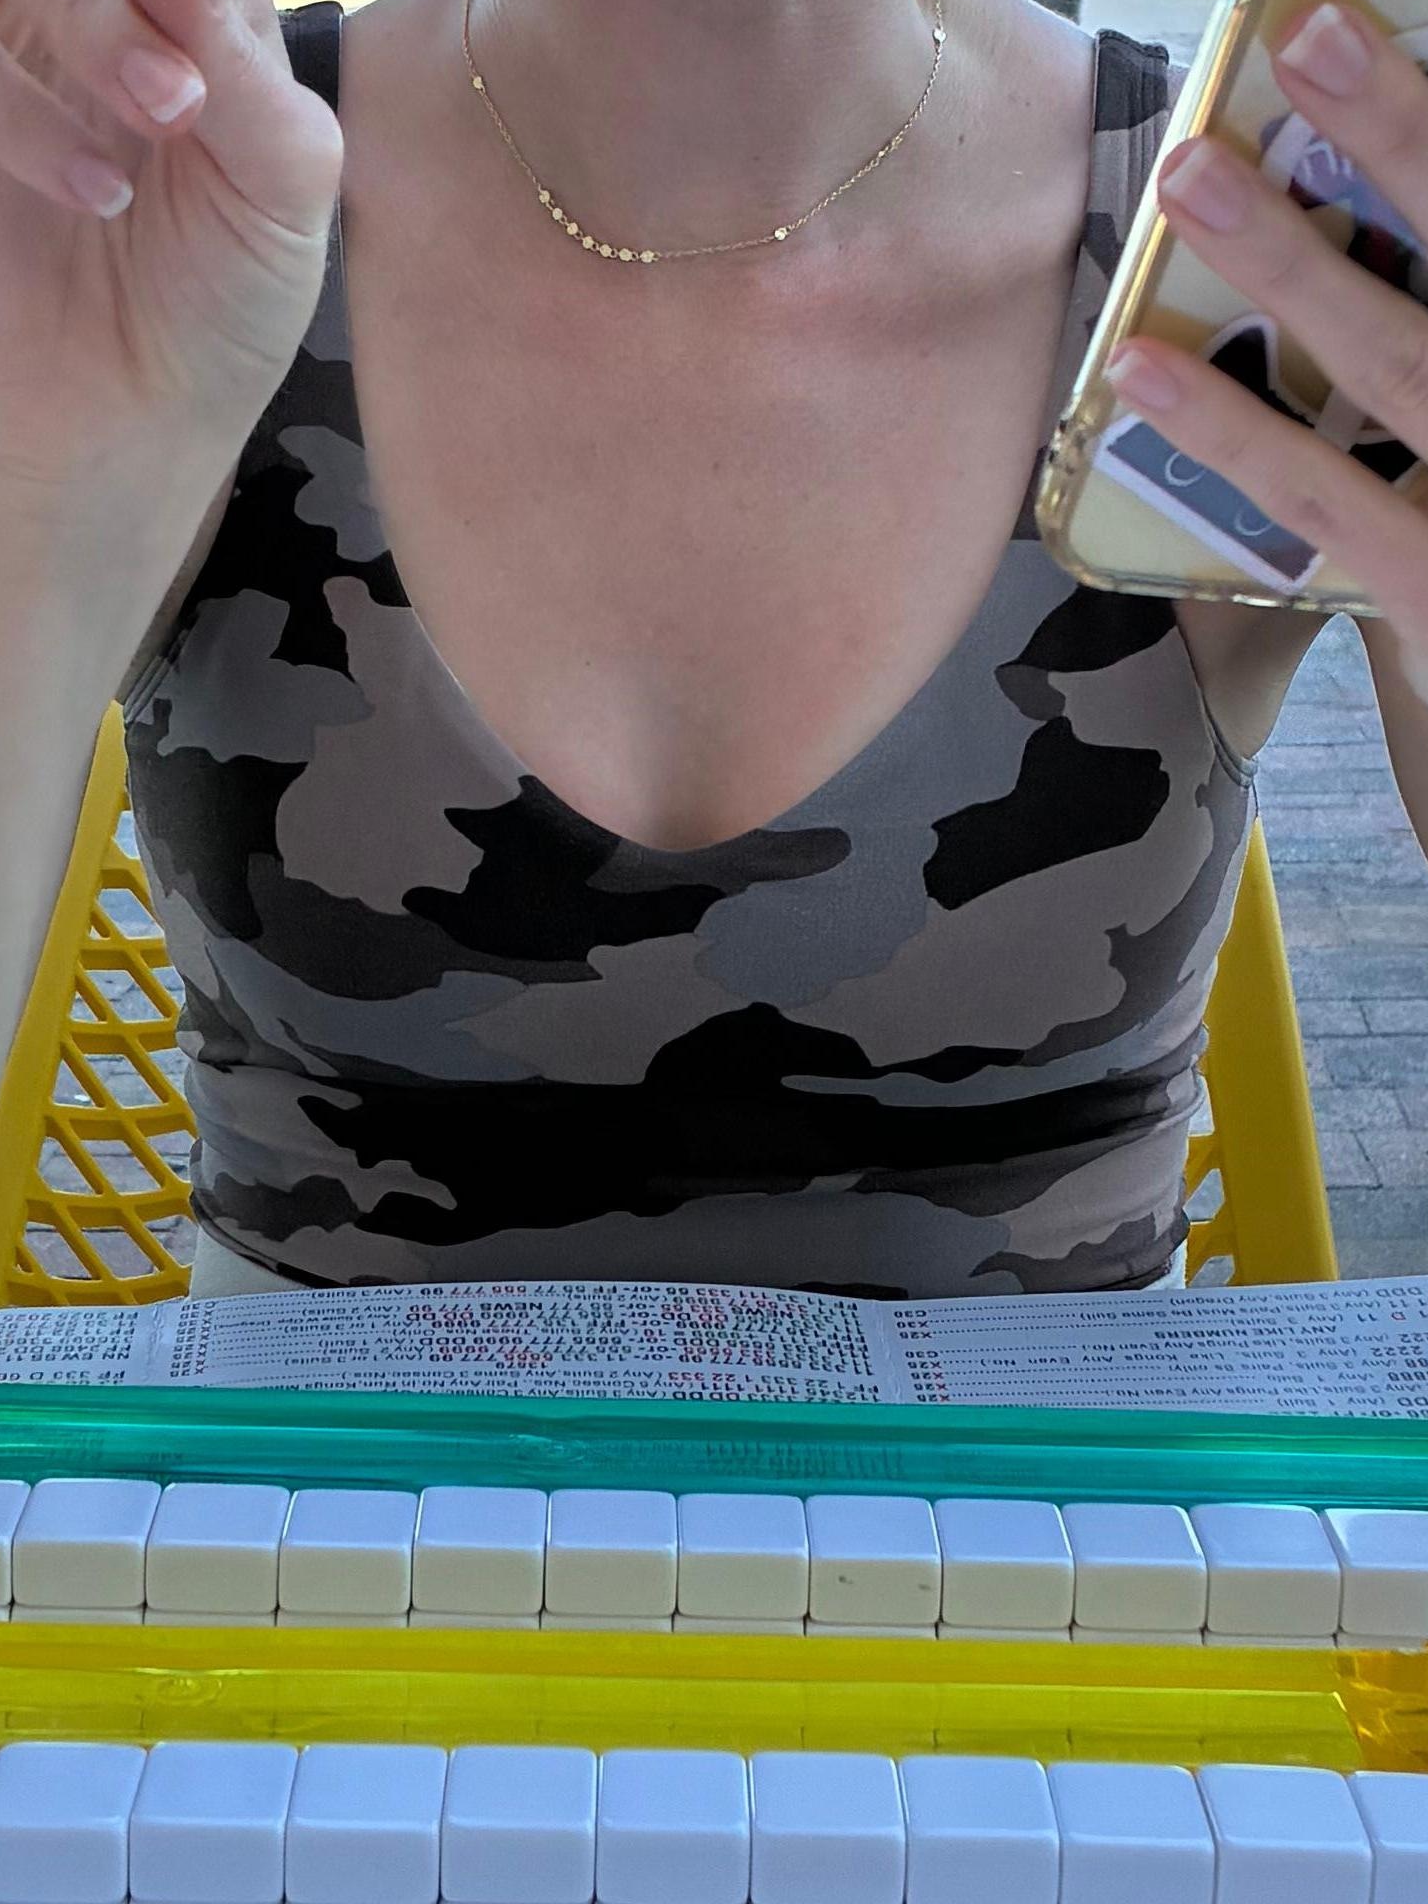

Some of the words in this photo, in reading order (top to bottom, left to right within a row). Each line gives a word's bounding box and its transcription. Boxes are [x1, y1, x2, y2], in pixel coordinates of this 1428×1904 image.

[1252, 1327, 1294, 1335] LIKE
[1301, 1326, 1336, 1334] ANY
[1370, 1346, 1423, 1356] 2222
